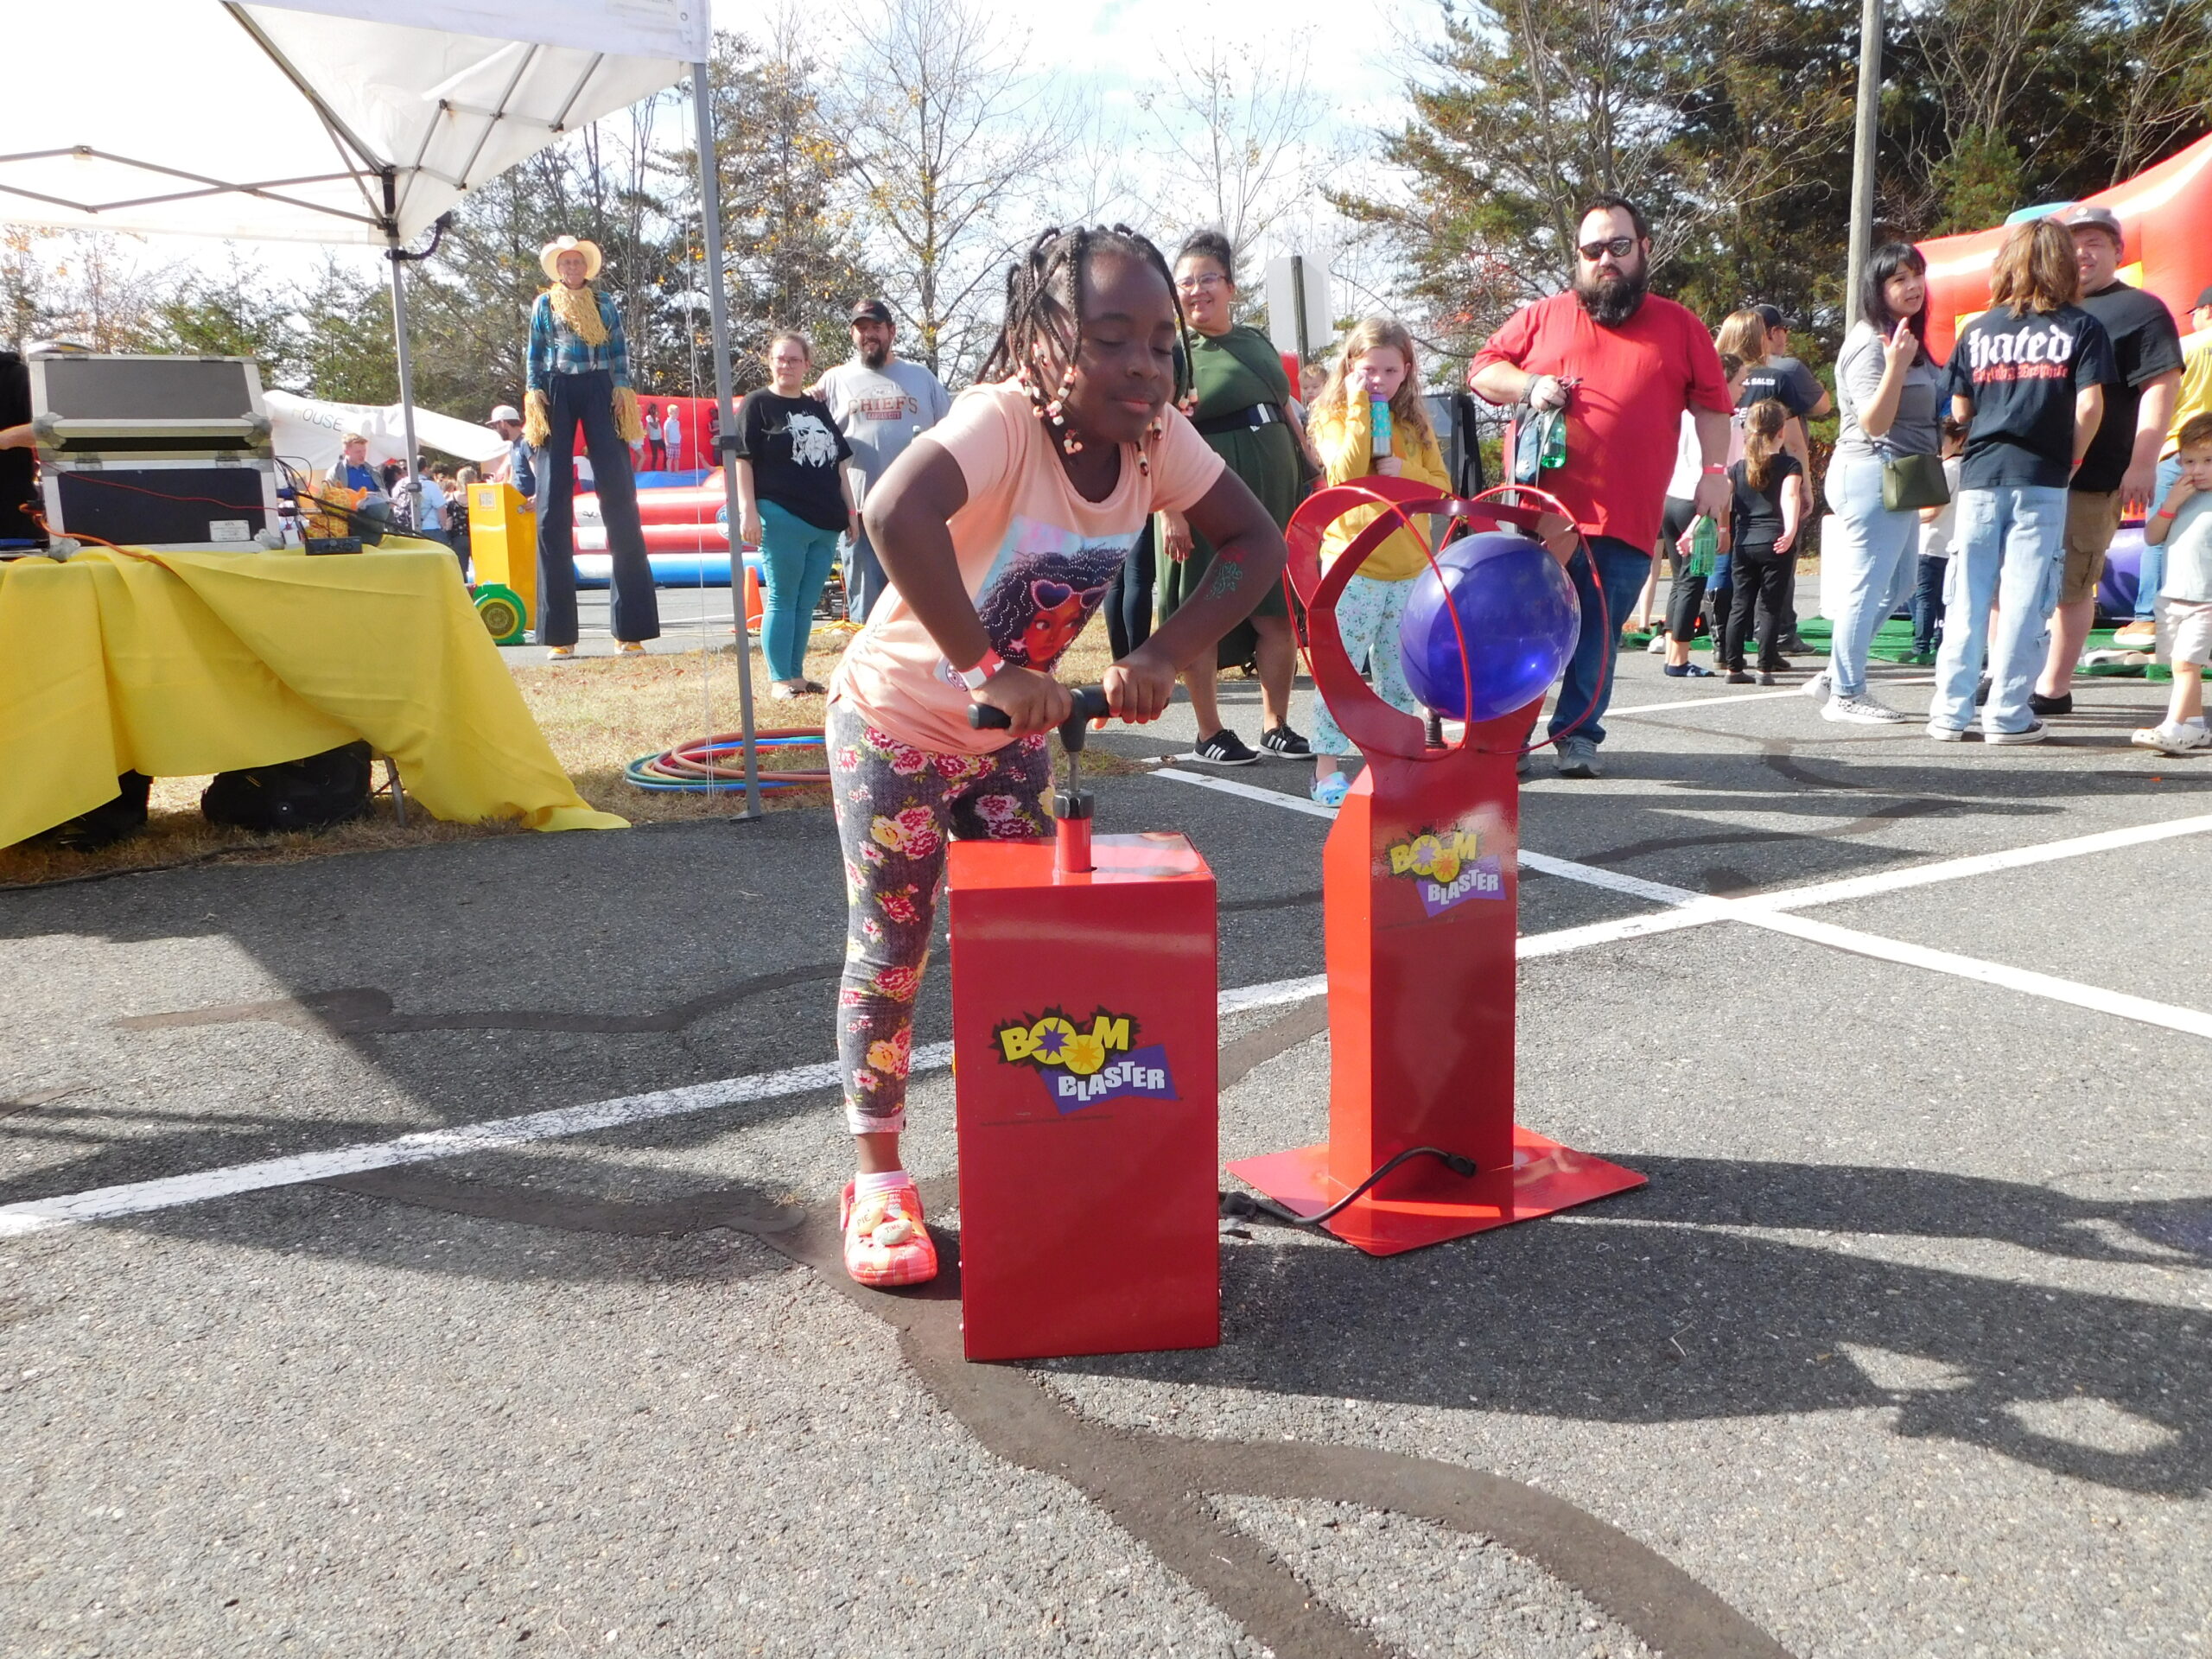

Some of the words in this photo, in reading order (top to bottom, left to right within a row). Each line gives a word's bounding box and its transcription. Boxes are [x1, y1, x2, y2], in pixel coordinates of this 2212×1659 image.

[1968, 324, 2073, 368] hated
[1751, 378, 1776, 386] SALES
[849, 396, 918, 415] CHIEFS
[1390, 831, 1478, 883] BOOM
[1427, 869, 1499, 906] BLASTER
[1000, 1015, 1130, 1075] BOOM
[1058, 1061, 1165, 1102] BLASTER
[857, 1214, 871, 1227] PIE
[885, 1224, 904, 1233] TIME
